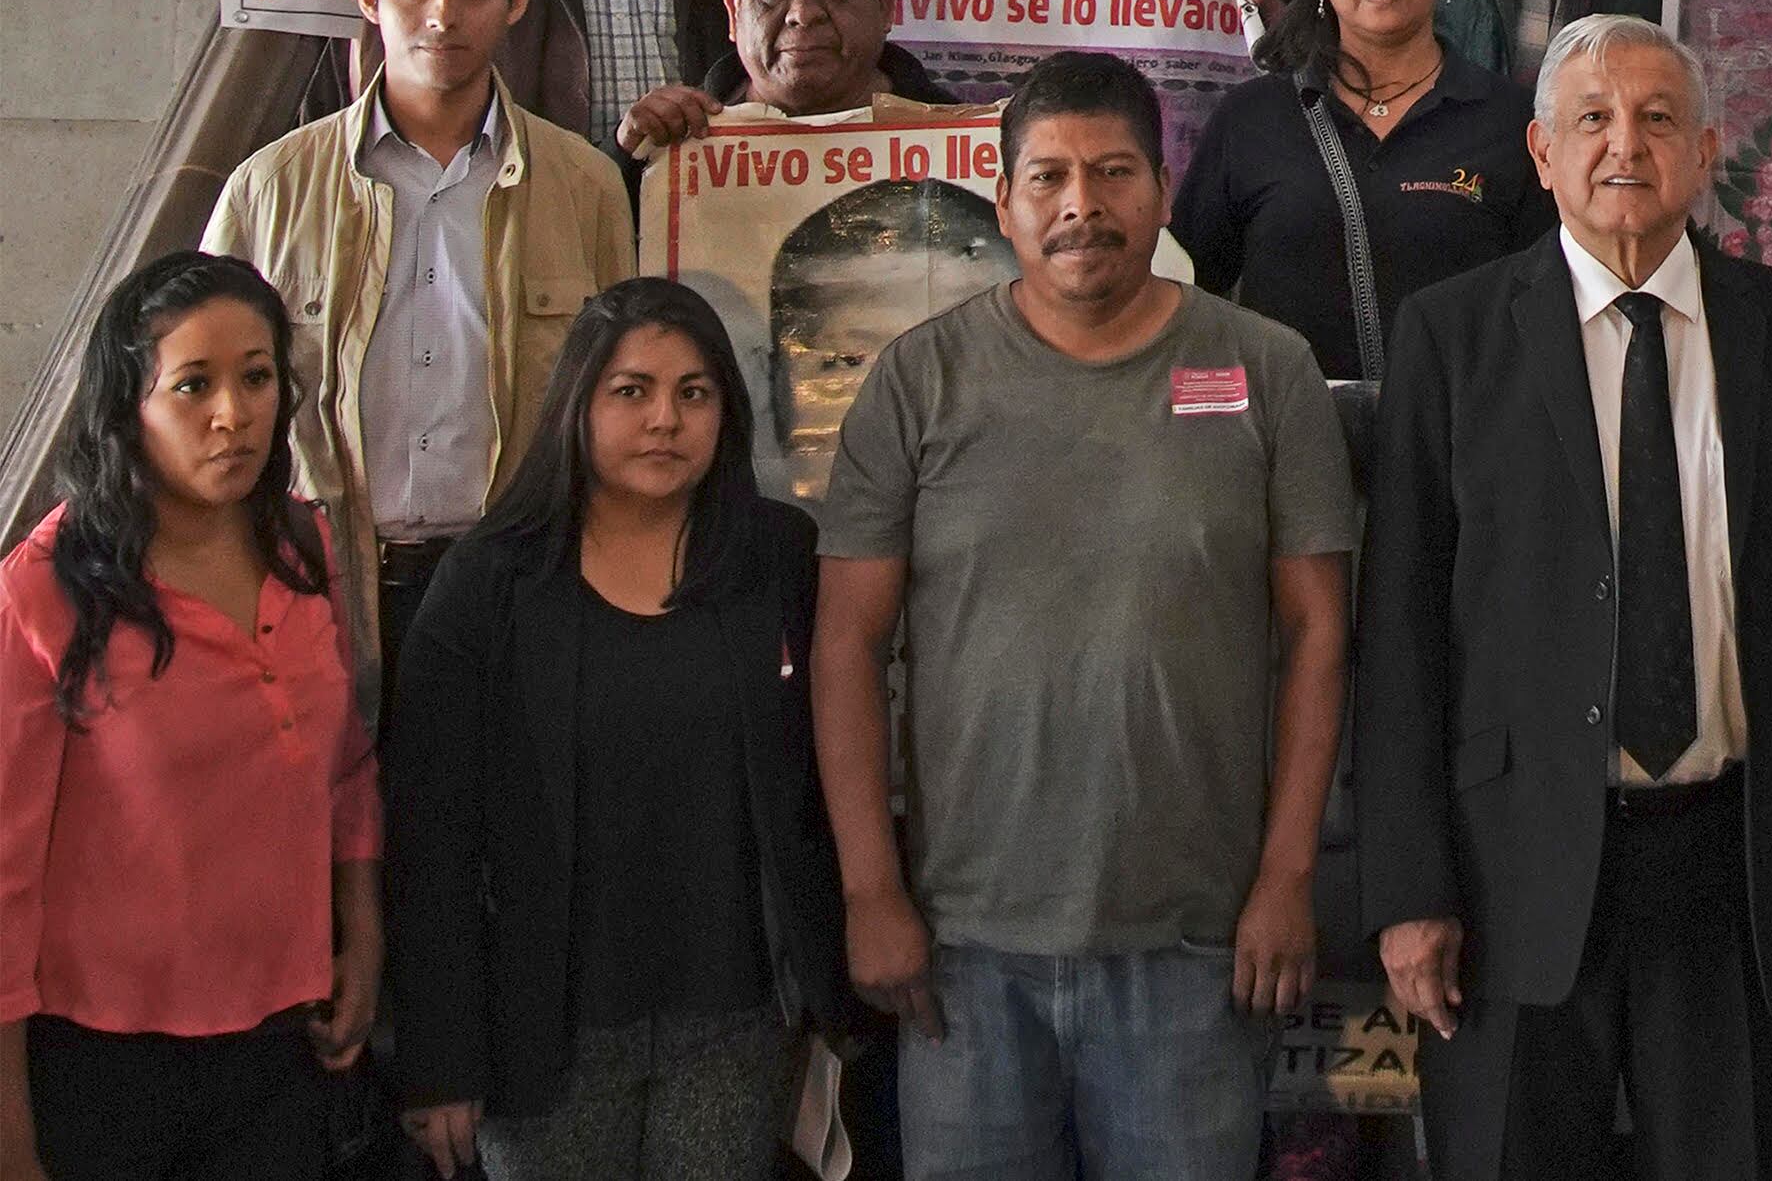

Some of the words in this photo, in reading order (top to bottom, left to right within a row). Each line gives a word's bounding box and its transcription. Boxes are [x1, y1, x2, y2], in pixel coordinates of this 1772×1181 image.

[687, 141, 809, 196] ¡Vivo
[823, 147, 873, 185] se
[889, 137, 930, 182] lo
[1451, 168, 1480, 192] 24
